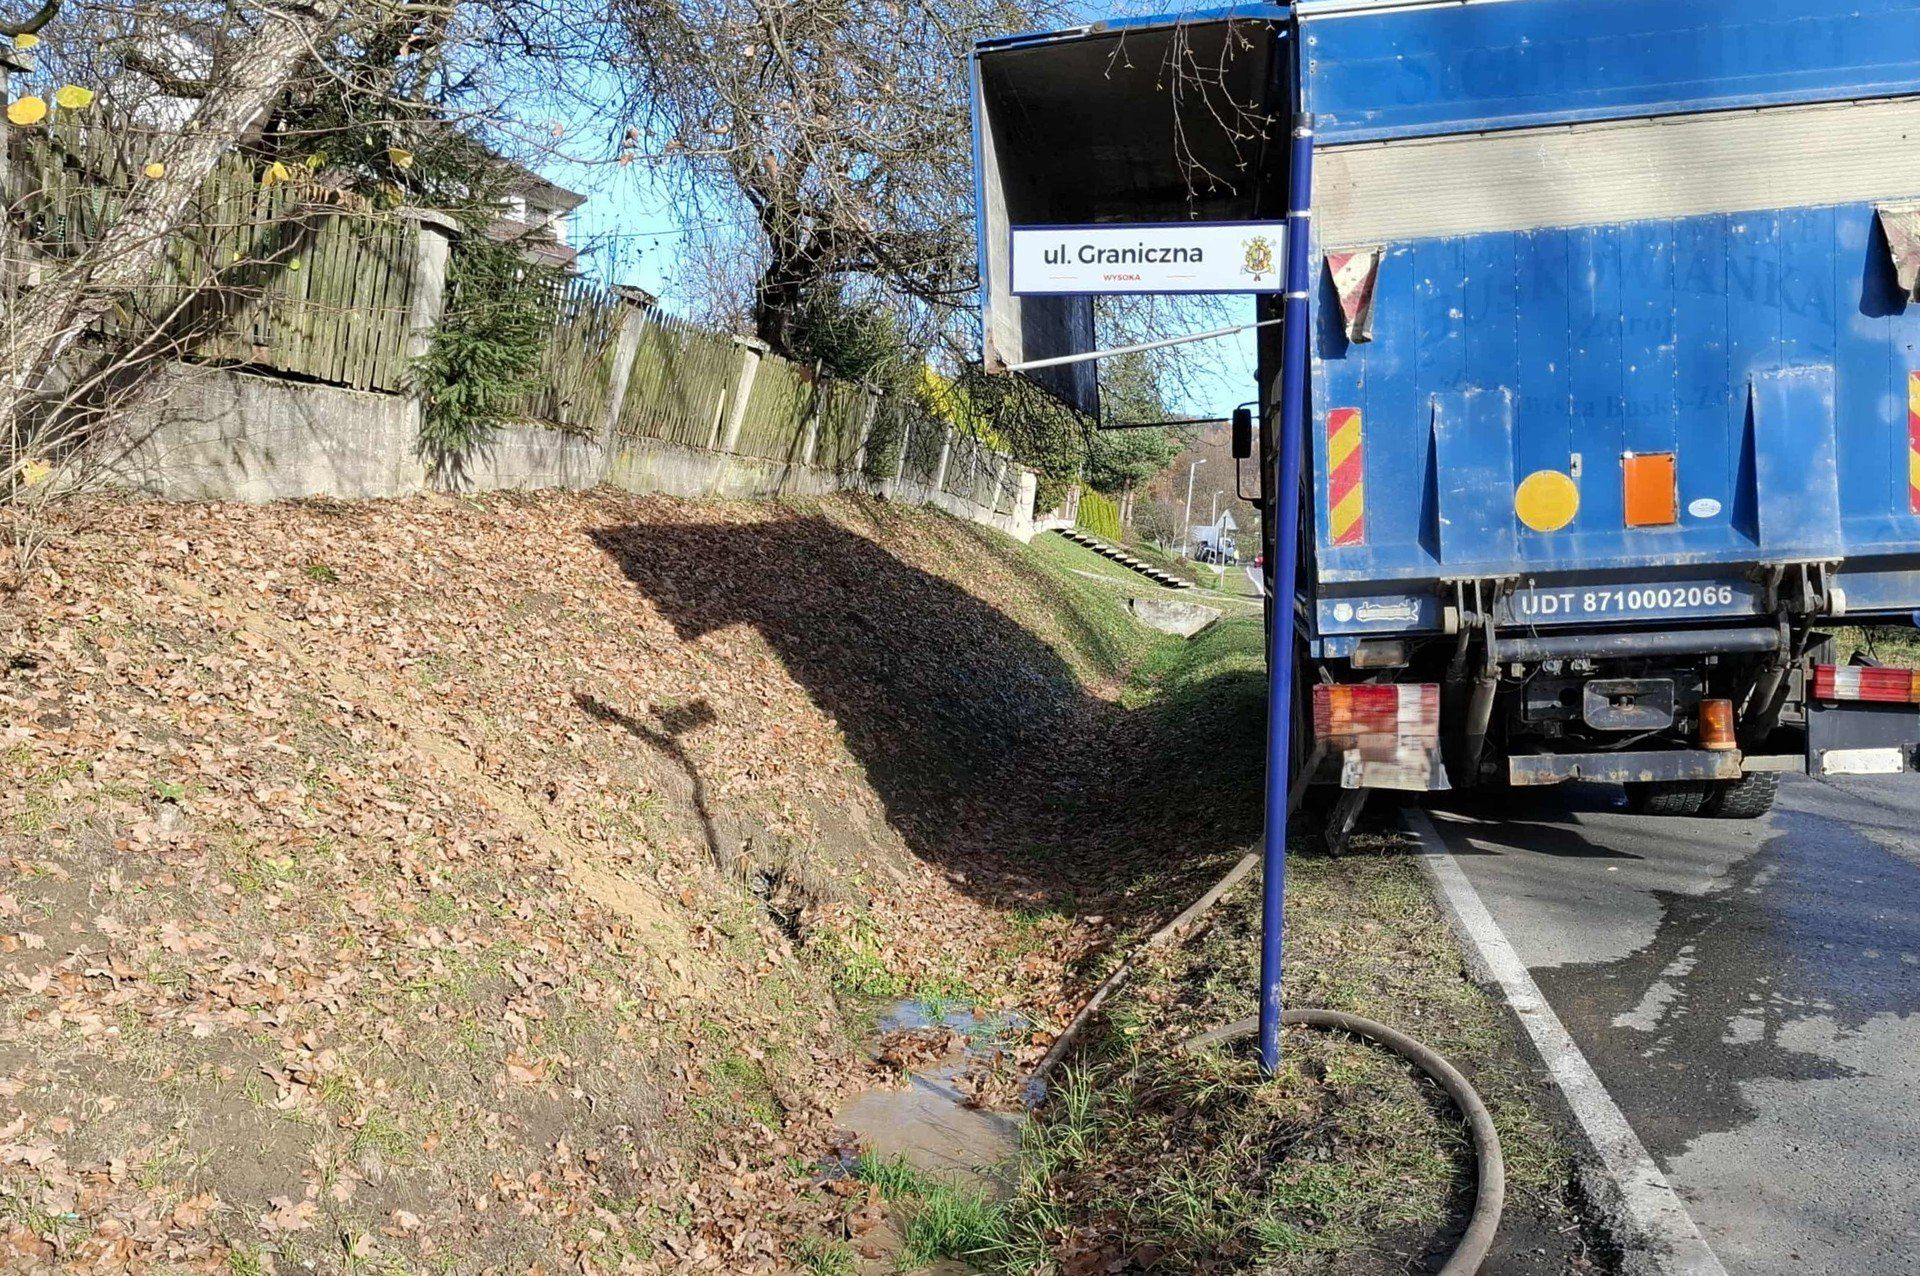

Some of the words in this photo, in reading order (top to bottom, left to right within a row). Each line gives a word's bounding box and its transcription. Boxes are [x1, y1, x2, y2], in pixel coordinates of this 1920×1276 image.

[1044, 243, 1072, 265] ul.
[1077, 242, 1203, 265] Graniczna
[1103, 273, 1142, 282] WYSOKA
[1521, 593, 1575, 615] UDT
[1583, 586, 1733, 612] 8710002066
